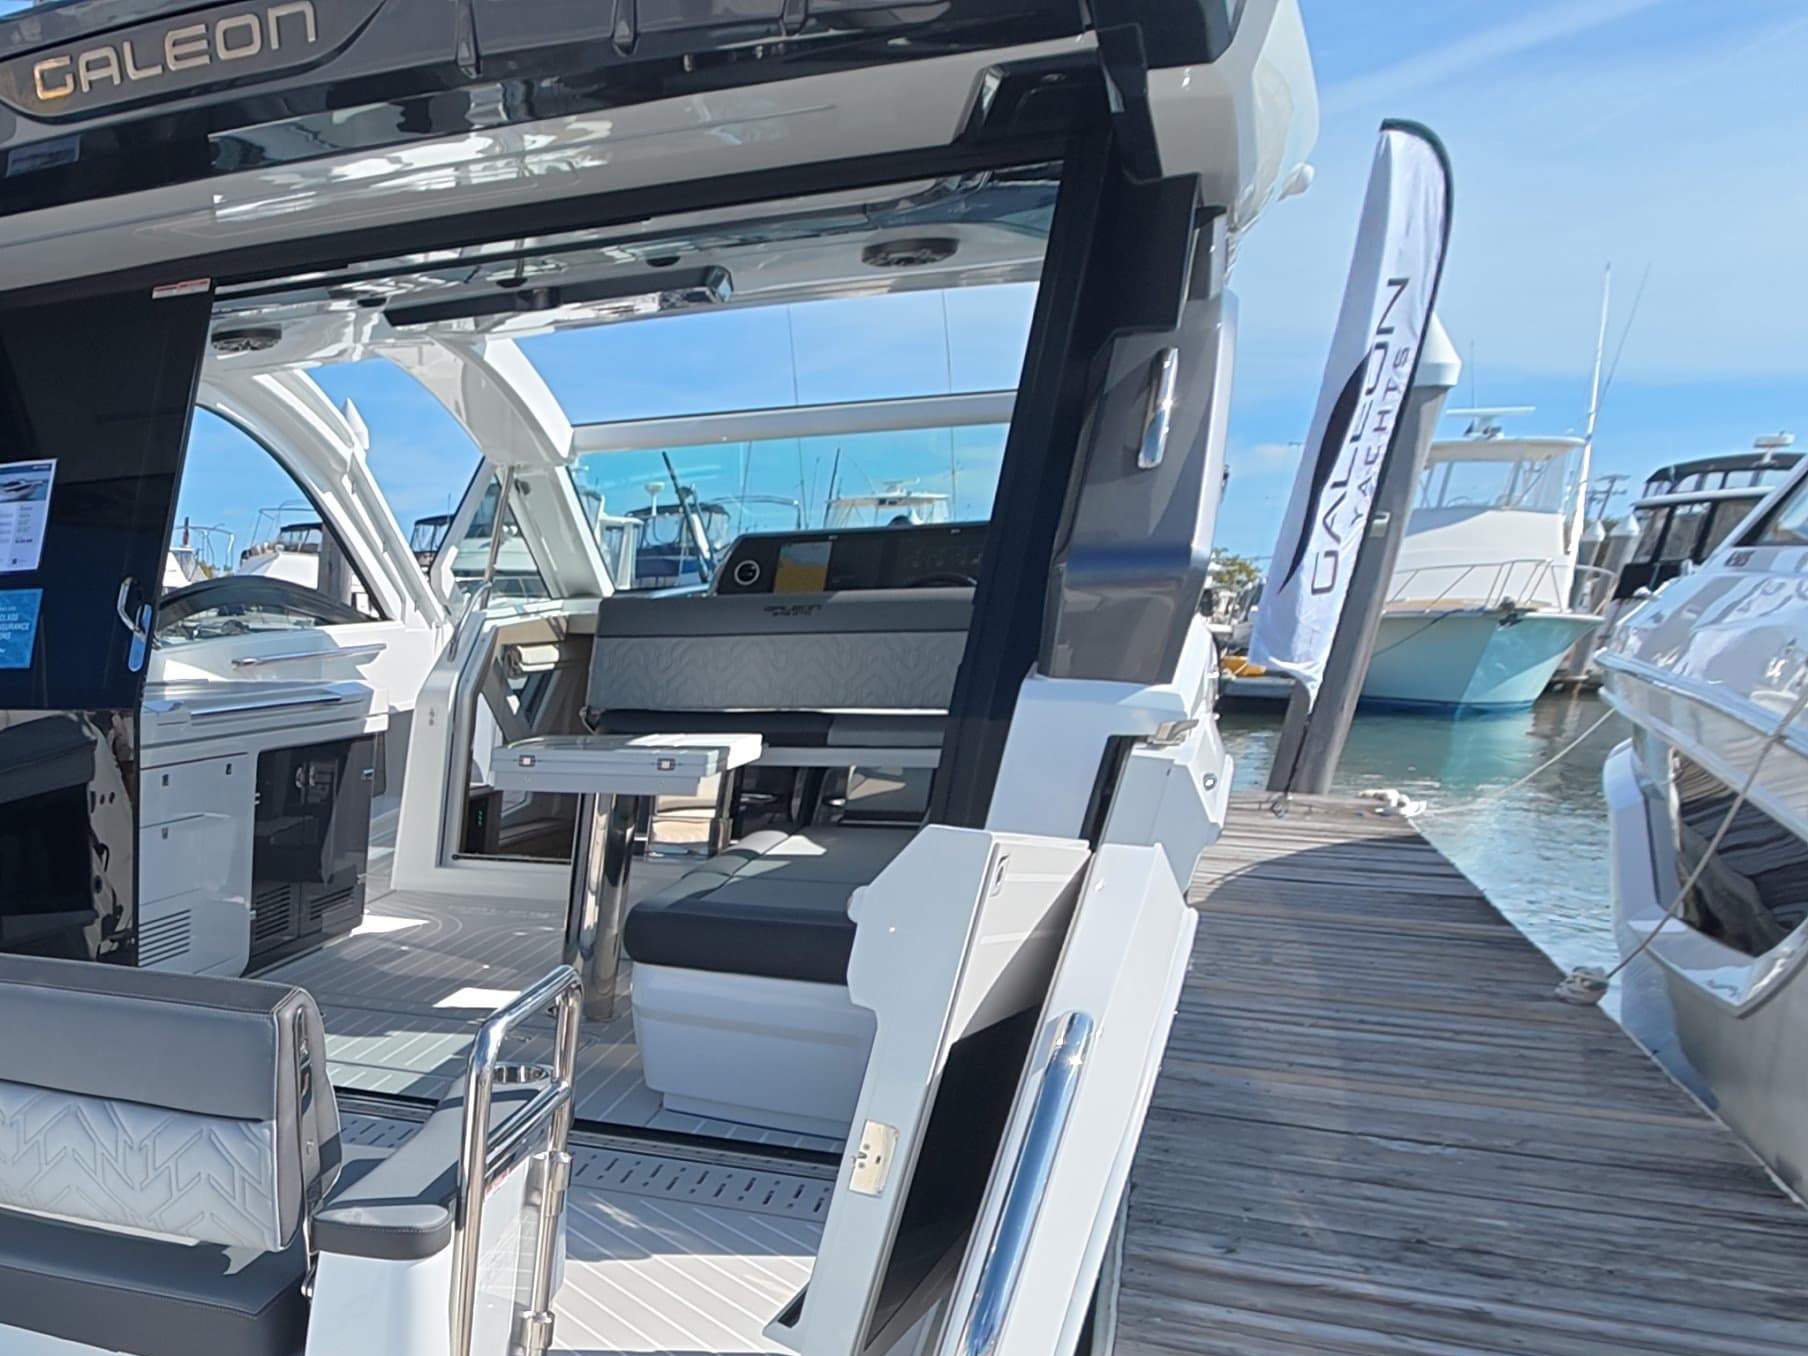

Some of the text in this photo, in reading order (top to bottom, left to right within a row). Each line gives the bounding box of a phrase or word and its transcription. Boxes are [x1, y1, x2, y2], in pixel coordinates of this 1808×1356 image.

[33, 0, 316, 99] GALEON
[1310, 277, 1409, 596] GALEON
[1350, 347, 1410, 528] YACHTS
